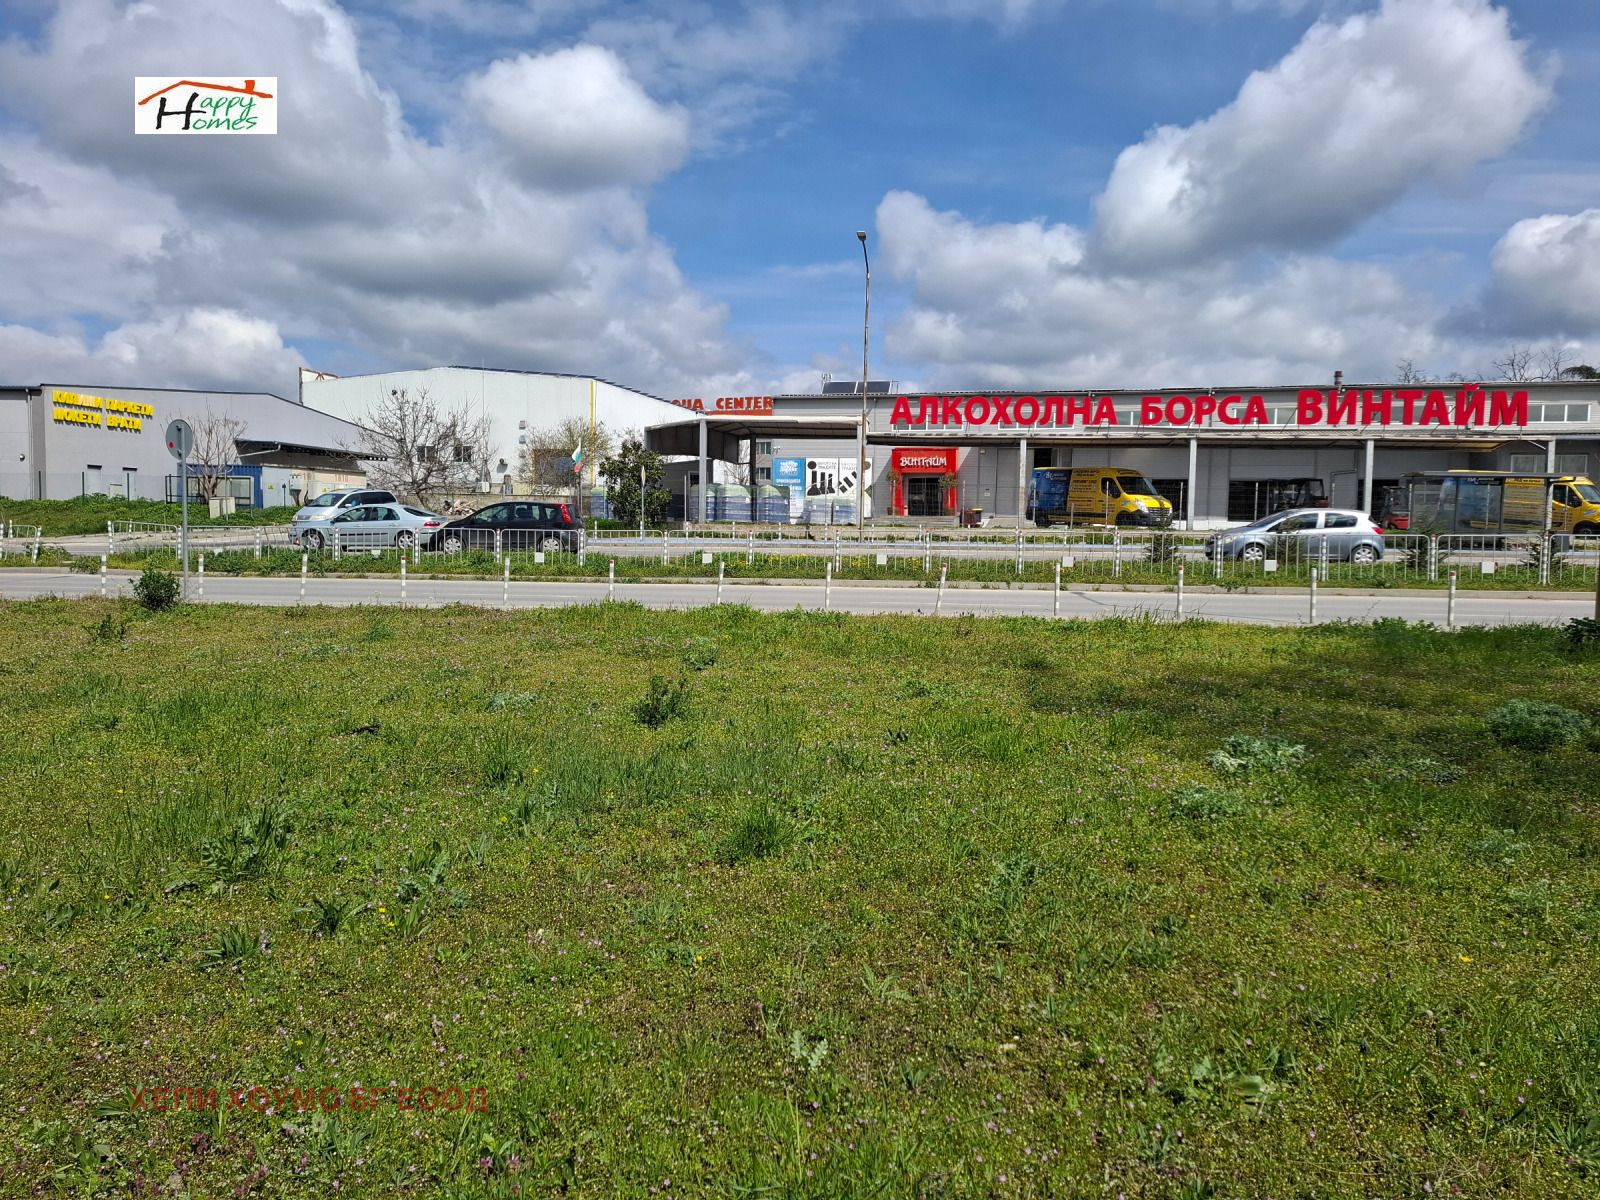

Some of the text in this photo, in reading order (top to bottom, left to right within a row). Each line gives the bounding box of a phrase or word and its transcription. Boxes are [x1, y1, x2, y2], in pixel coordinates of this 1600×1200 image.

[106, 398, 154, 416] ПАРКЕТИ
[716, 396, 773, 410] CENTER
[889, 384, 1529, 426] АЛКОХОЛНА БОРСА ВИНТАЙМ
[53, 408, 142, 430] МОКЕТИ ВРАТИ
